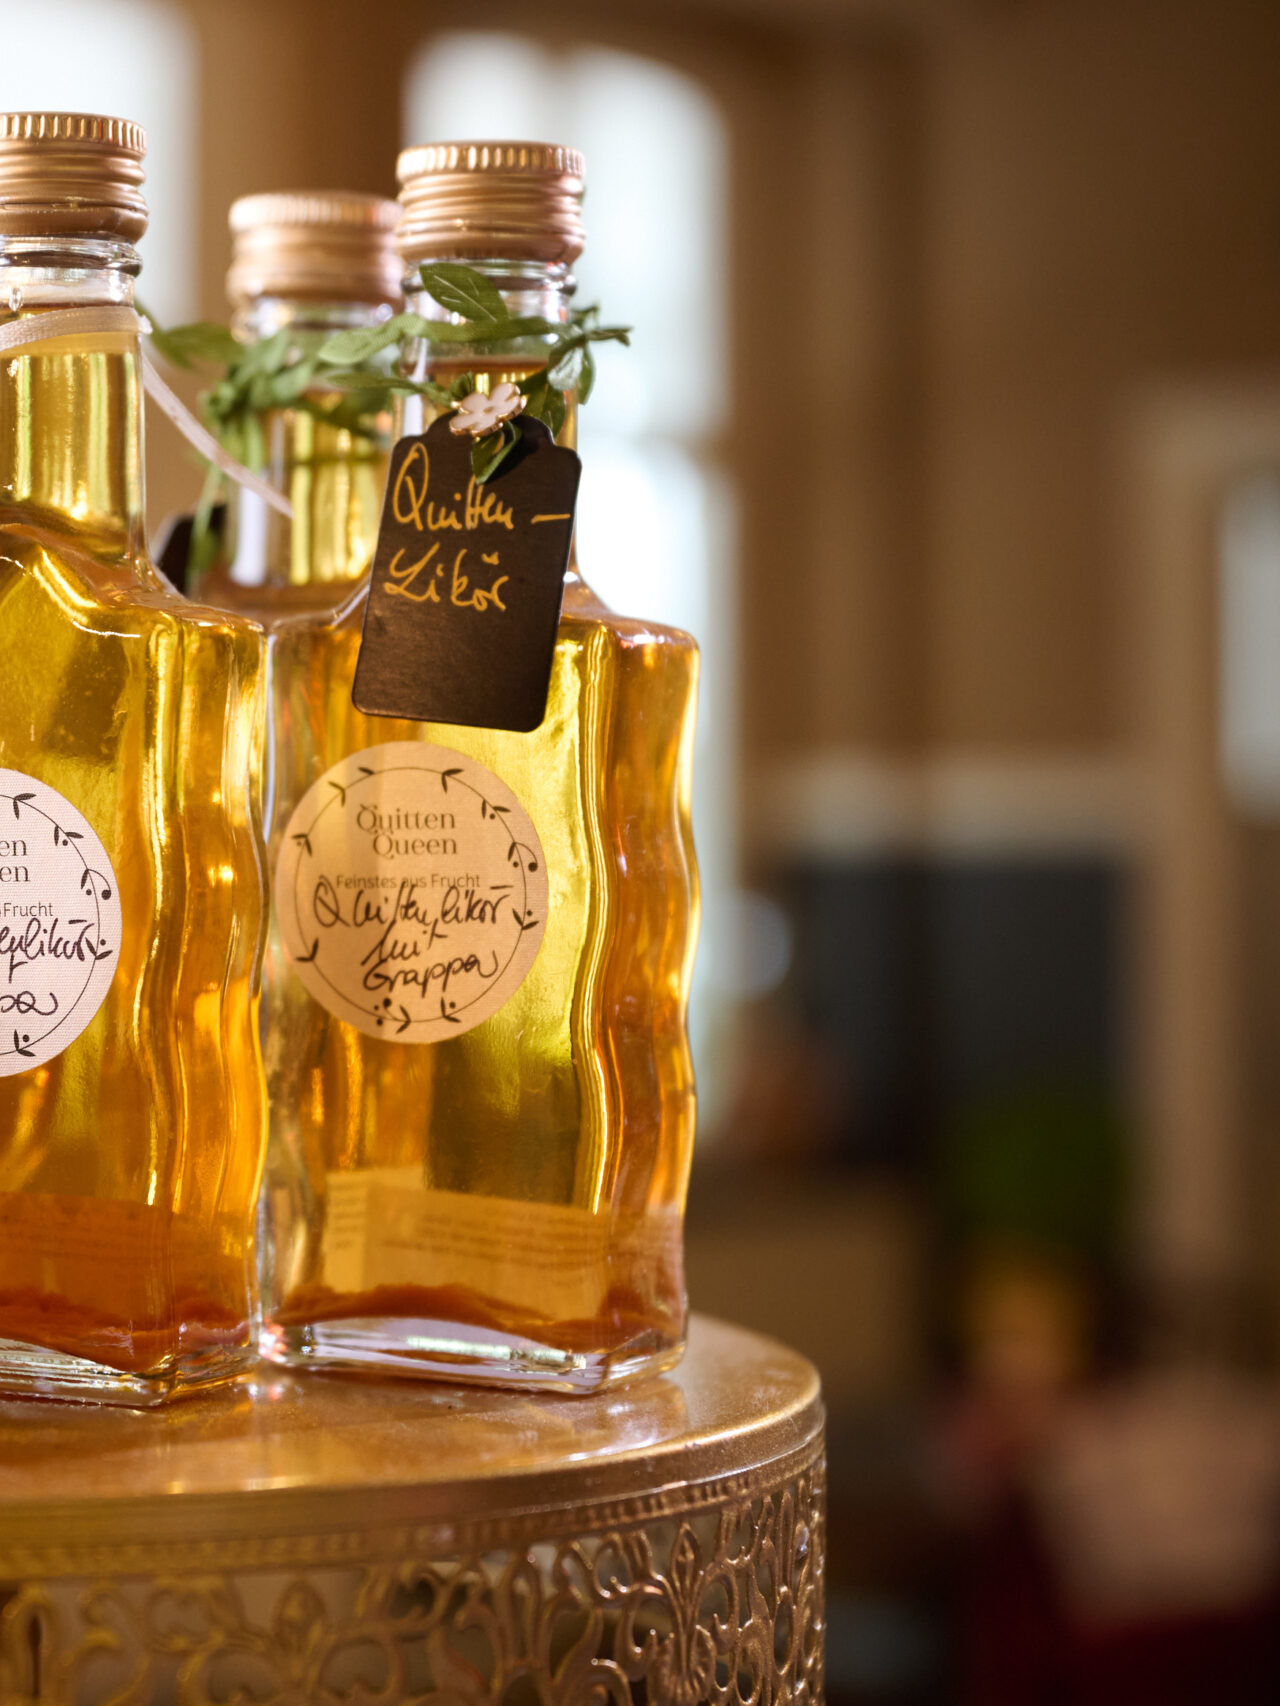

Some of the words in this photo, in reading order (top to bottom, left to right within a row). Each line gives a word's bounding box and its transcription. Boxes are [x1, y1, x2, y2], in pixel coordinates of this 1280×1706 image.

[383, 542, 509, 612] Likör
[355, 803, 456, 833] Quitten
[372, 831, 458, 859] Queen
[336, 874, 398, 889] Feinstes
[431, 872, 481, 890] Frucht
[3, 902, 54, 918] Frucht
[363, 950, 499, 998] Grappa
